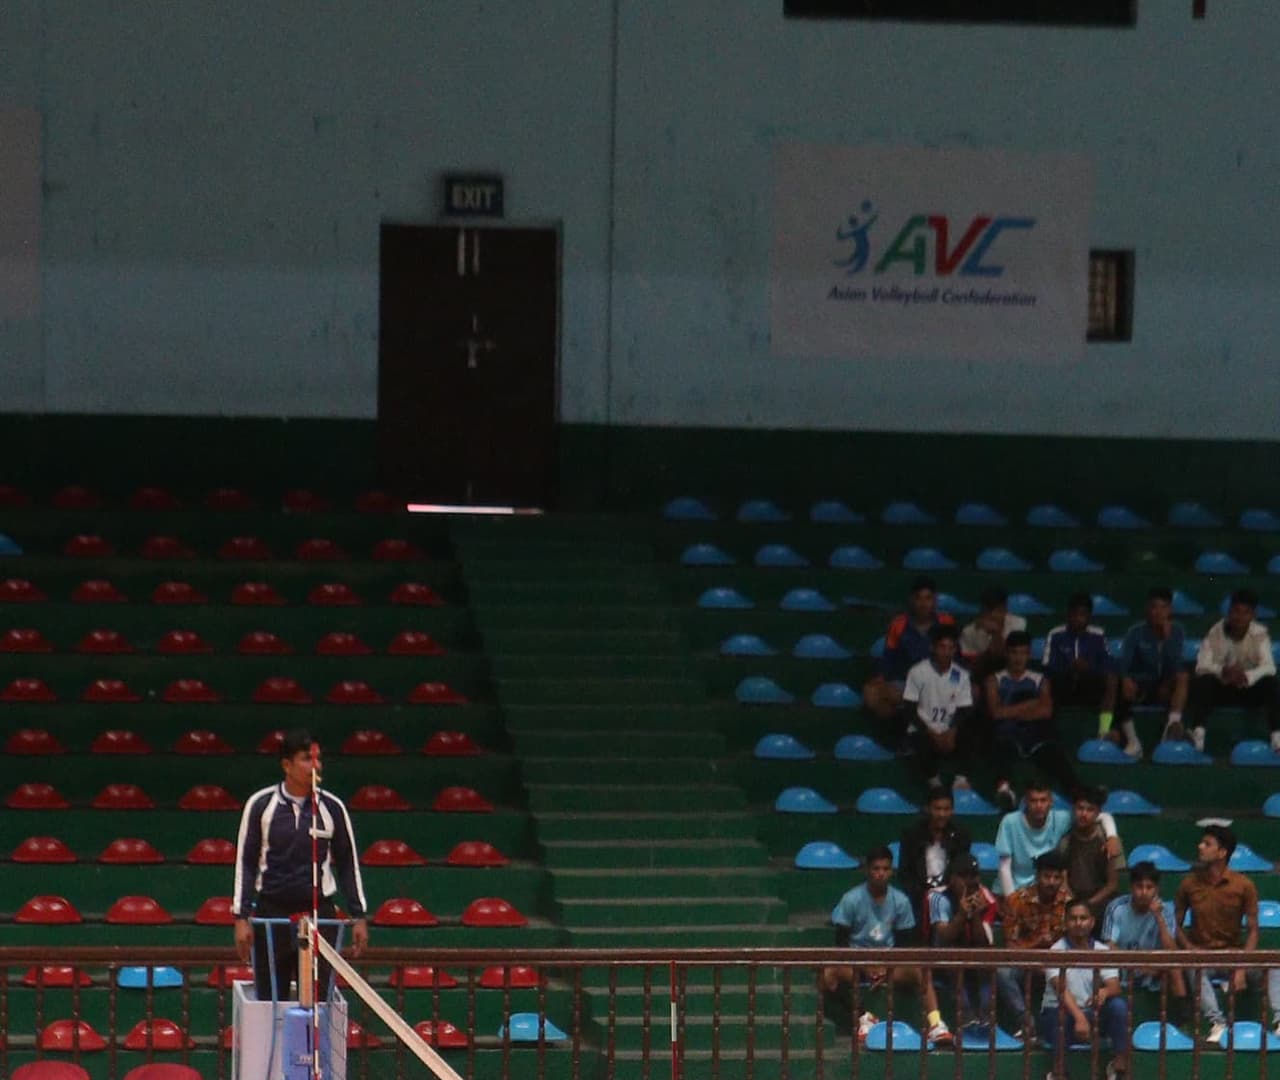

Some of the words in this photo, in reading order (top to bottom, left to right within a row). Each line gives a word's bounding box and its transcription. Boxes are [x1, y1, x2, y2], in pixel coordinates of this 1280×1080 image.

[451, 183, 496, 210] EXIT
[874, 215, 1036, 276] AVC
[871, 286, 939, 305] Volleyball
[941, 288, 1037, 306] Confederation
